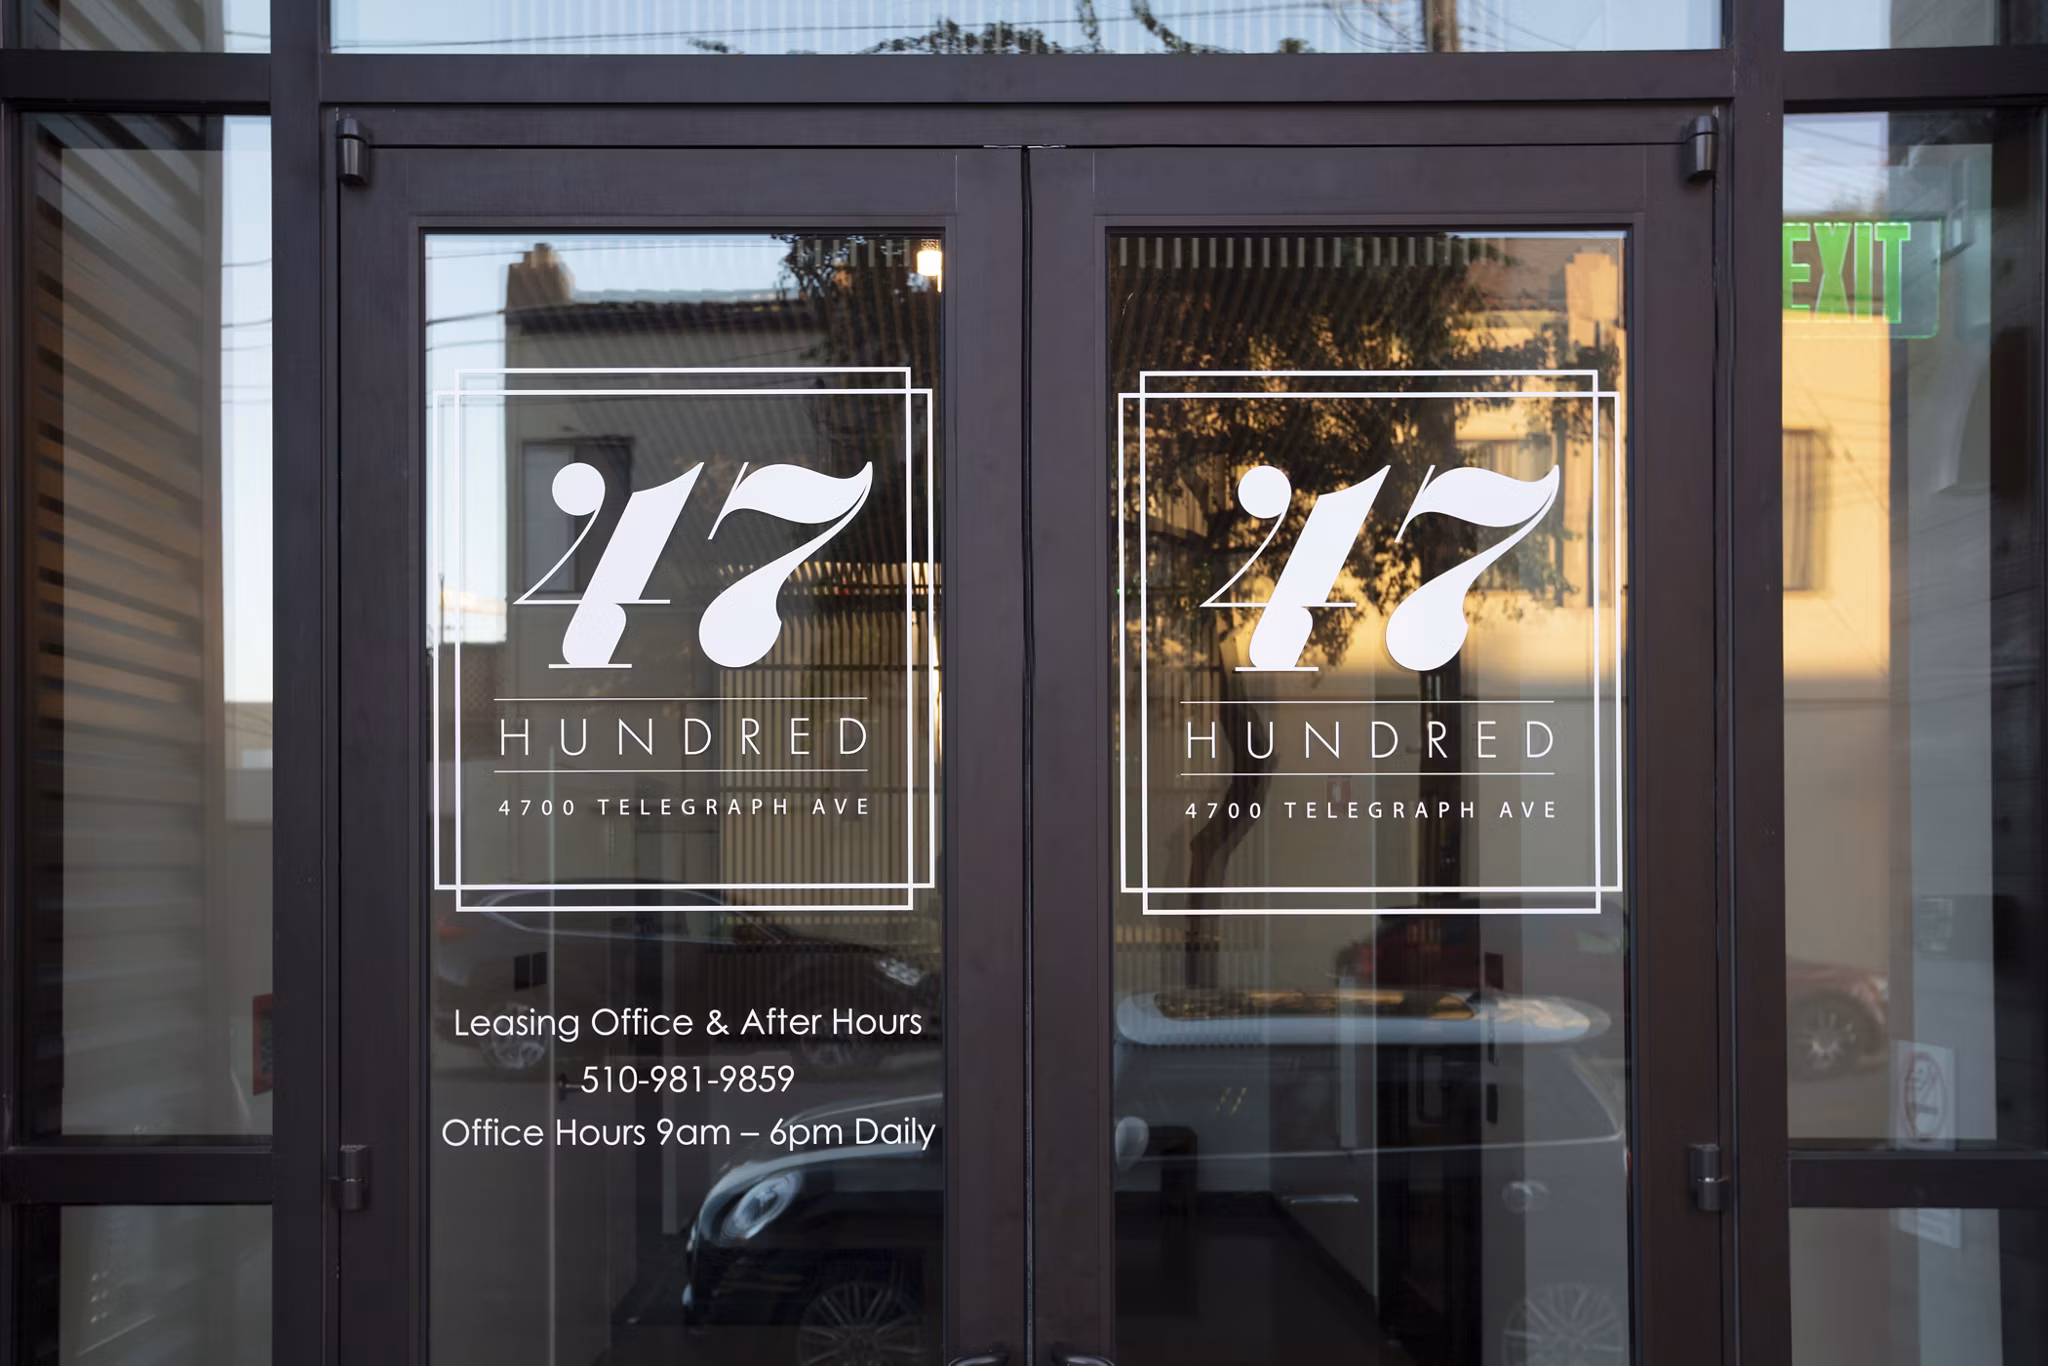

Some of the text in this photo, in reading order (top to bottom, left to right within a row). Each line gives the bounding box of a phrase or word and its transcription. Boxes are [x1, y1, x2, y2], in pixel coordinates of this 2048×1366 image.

[1783, 222, 1911, 323] EXIT
[513, 461, 873, 669] 47
[1199, 464, 1560, 672] 47
[500, 717, 868, 756] HUNDRED
[1187, 720, 1555, 759] HUNDRED
[499, 798, 869, 817] 4700 TELEGRAPH AVE
[1185, 801, 1556, 819] 4700 TELEGRAPH AVE
[454, 1008, 923, 1043] Leasing Office & After Hours
[580, 1065, 795, 1093] 510-981-9859
[441, 1118, 544, 1147] Office
[555, 1119, 647, 1146] Hours
[655, 1118, 731, 1146] 9am
[769, 1118, 843, 1151] 6pm
[855, 1117, 936, 1151] Daily
